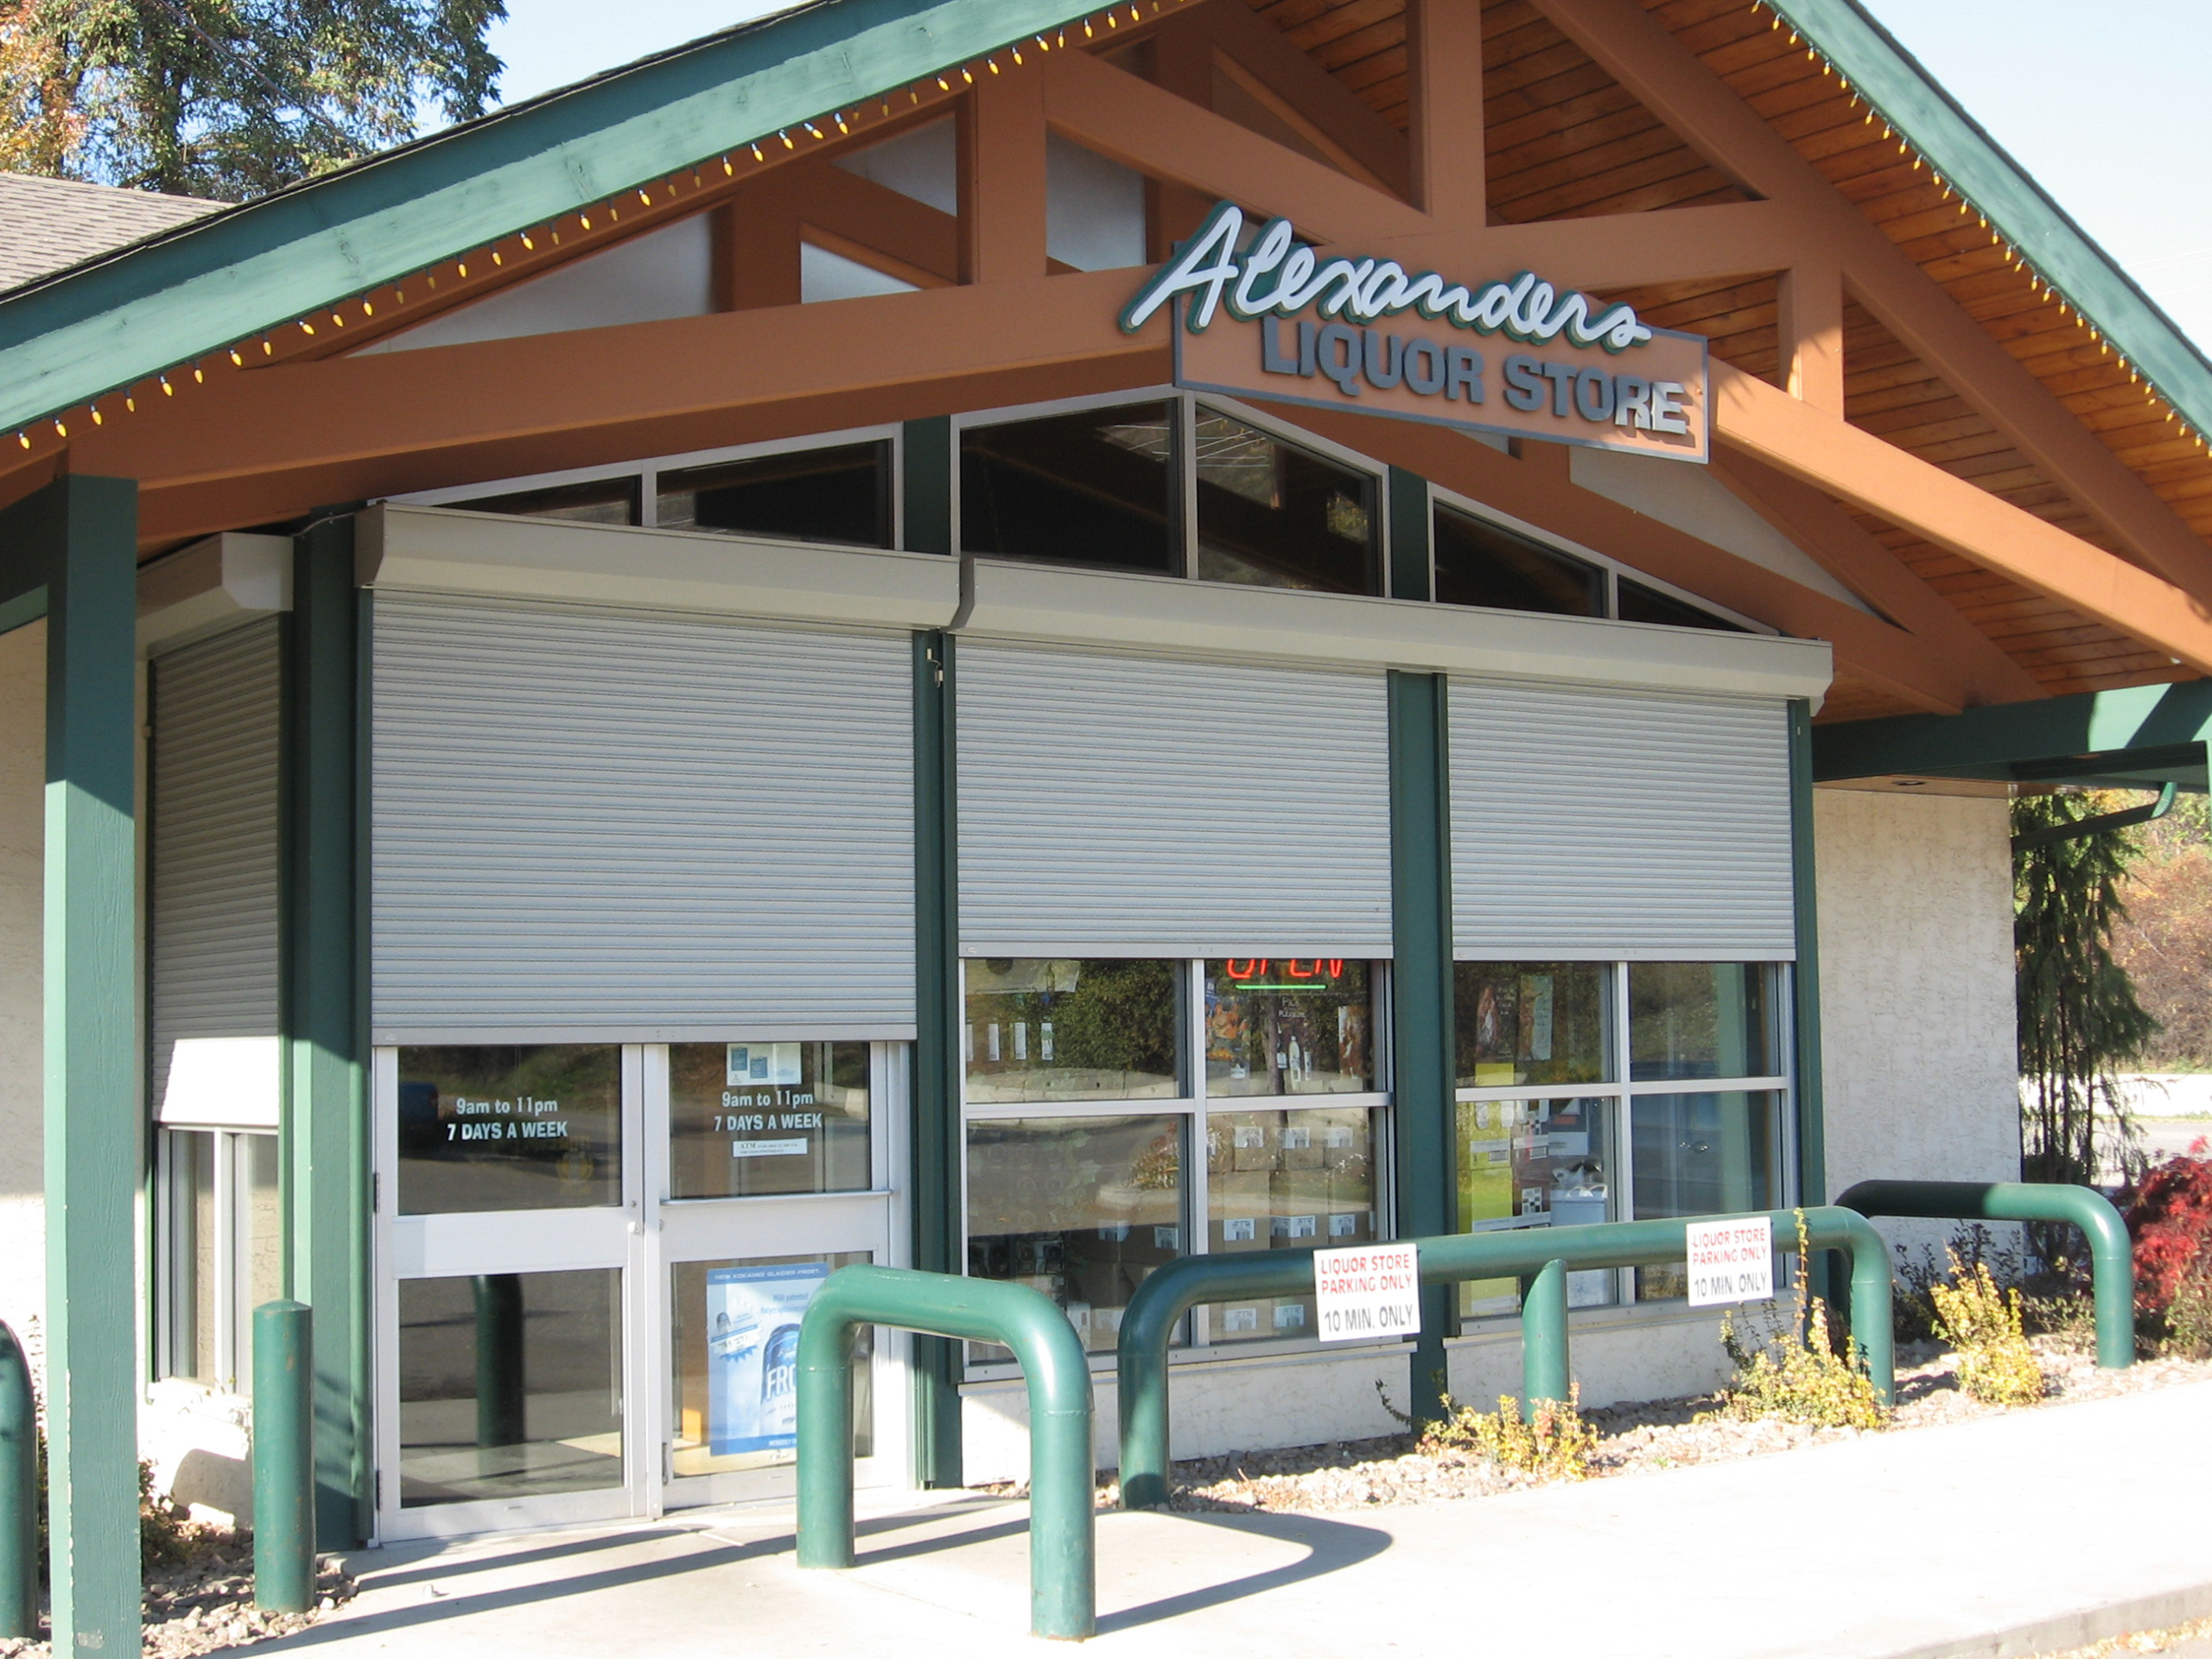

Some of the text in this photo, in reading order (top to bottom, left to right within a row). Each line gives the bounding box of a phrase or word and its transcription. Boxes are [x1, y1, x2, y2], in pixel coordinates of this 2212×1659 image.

[1122, 202, 1653, 351] Alexanders
[1262, 316, 1687, 435] LIQUOR STORE
[456, 1096, 558, 1117] 9am to 11pm
[721, 1090, 813, 1109] 9am to 11pm
[447, 1121, 568, 1141] 7 DAYS A WEEK
[714, 1113, 823, 1132] 7 DAYS A WEEK
[1691, 1228, 1765, 1249] LIQUOR STORE
[1321, 1254, 1409, 1276] LIQUOR STORE
[1693, 1246, 1767, 1267] PARKING ONLY
[1321, 1274, 1412, 1295] PARKING ONLY
[1694, 1272, 1767, 1298] 10 MIN. ONLY
[1324, 1304, 1413, 1332] 10 MIN. ONLY
[766, 1363, 797, 1402] FRO
